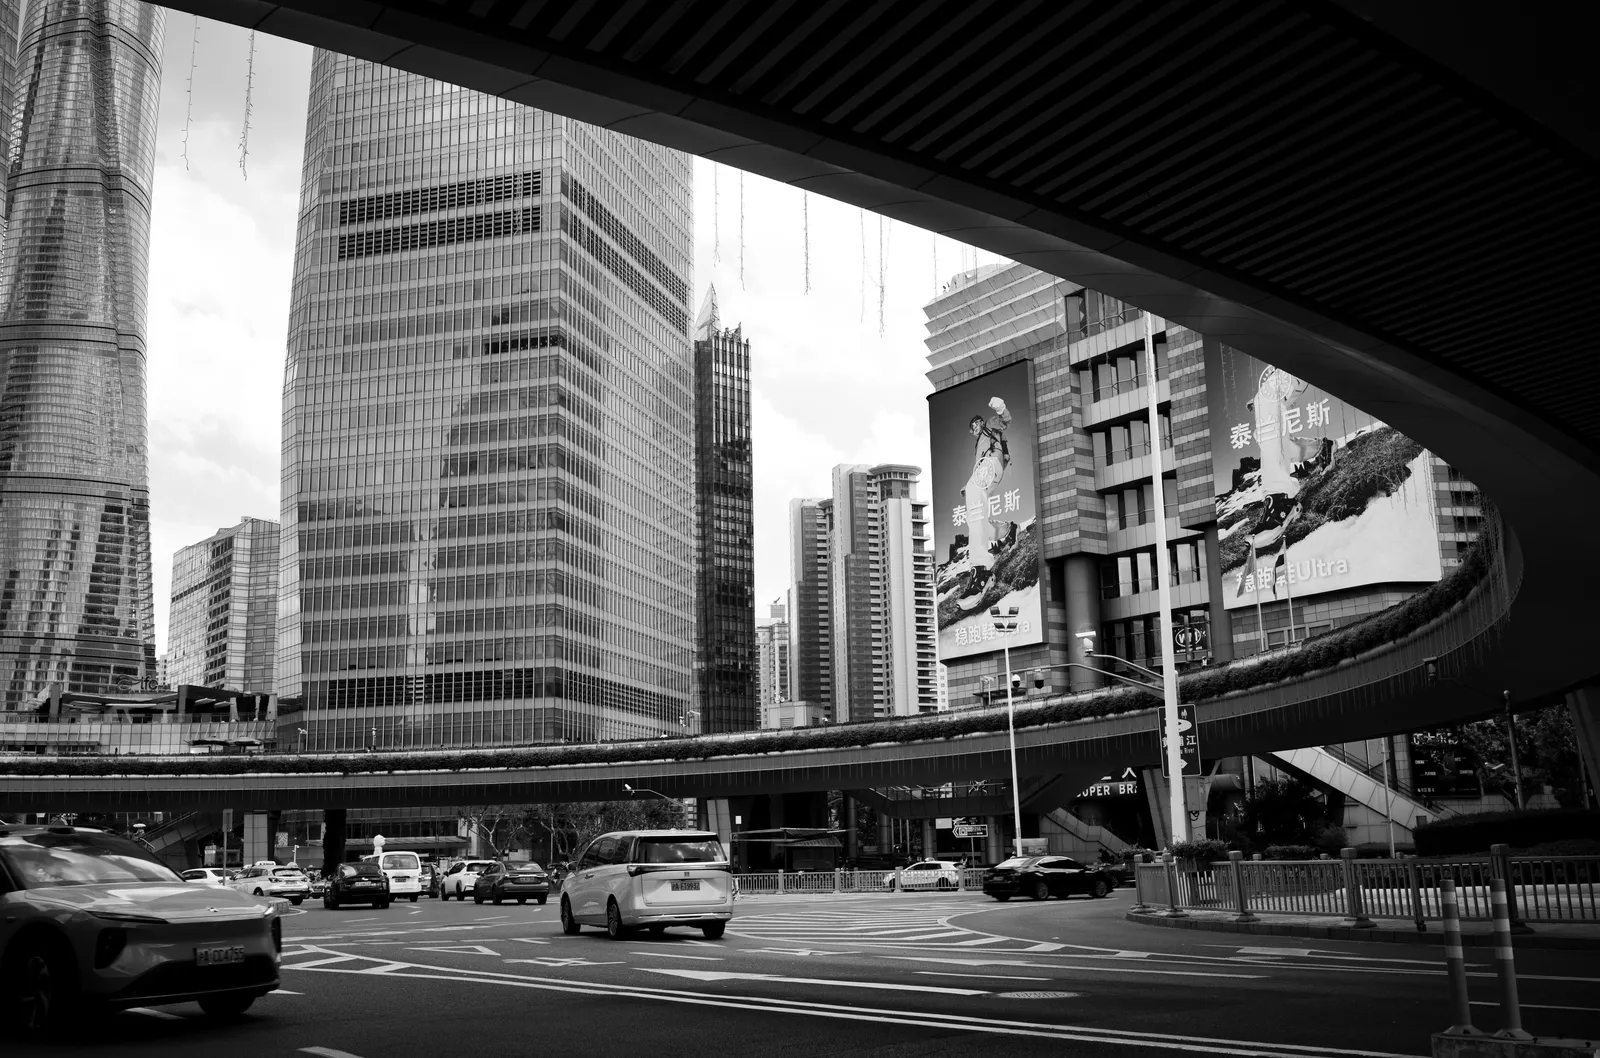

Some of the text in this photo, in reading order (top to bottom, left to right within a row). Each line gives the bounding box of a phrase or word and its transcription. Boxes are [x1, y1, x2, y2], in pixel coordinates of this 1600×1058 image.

[1230, 398, 1330, 449] 泰兰尼斯
[952, 488, 1020, 526] 泰兰尼斯
